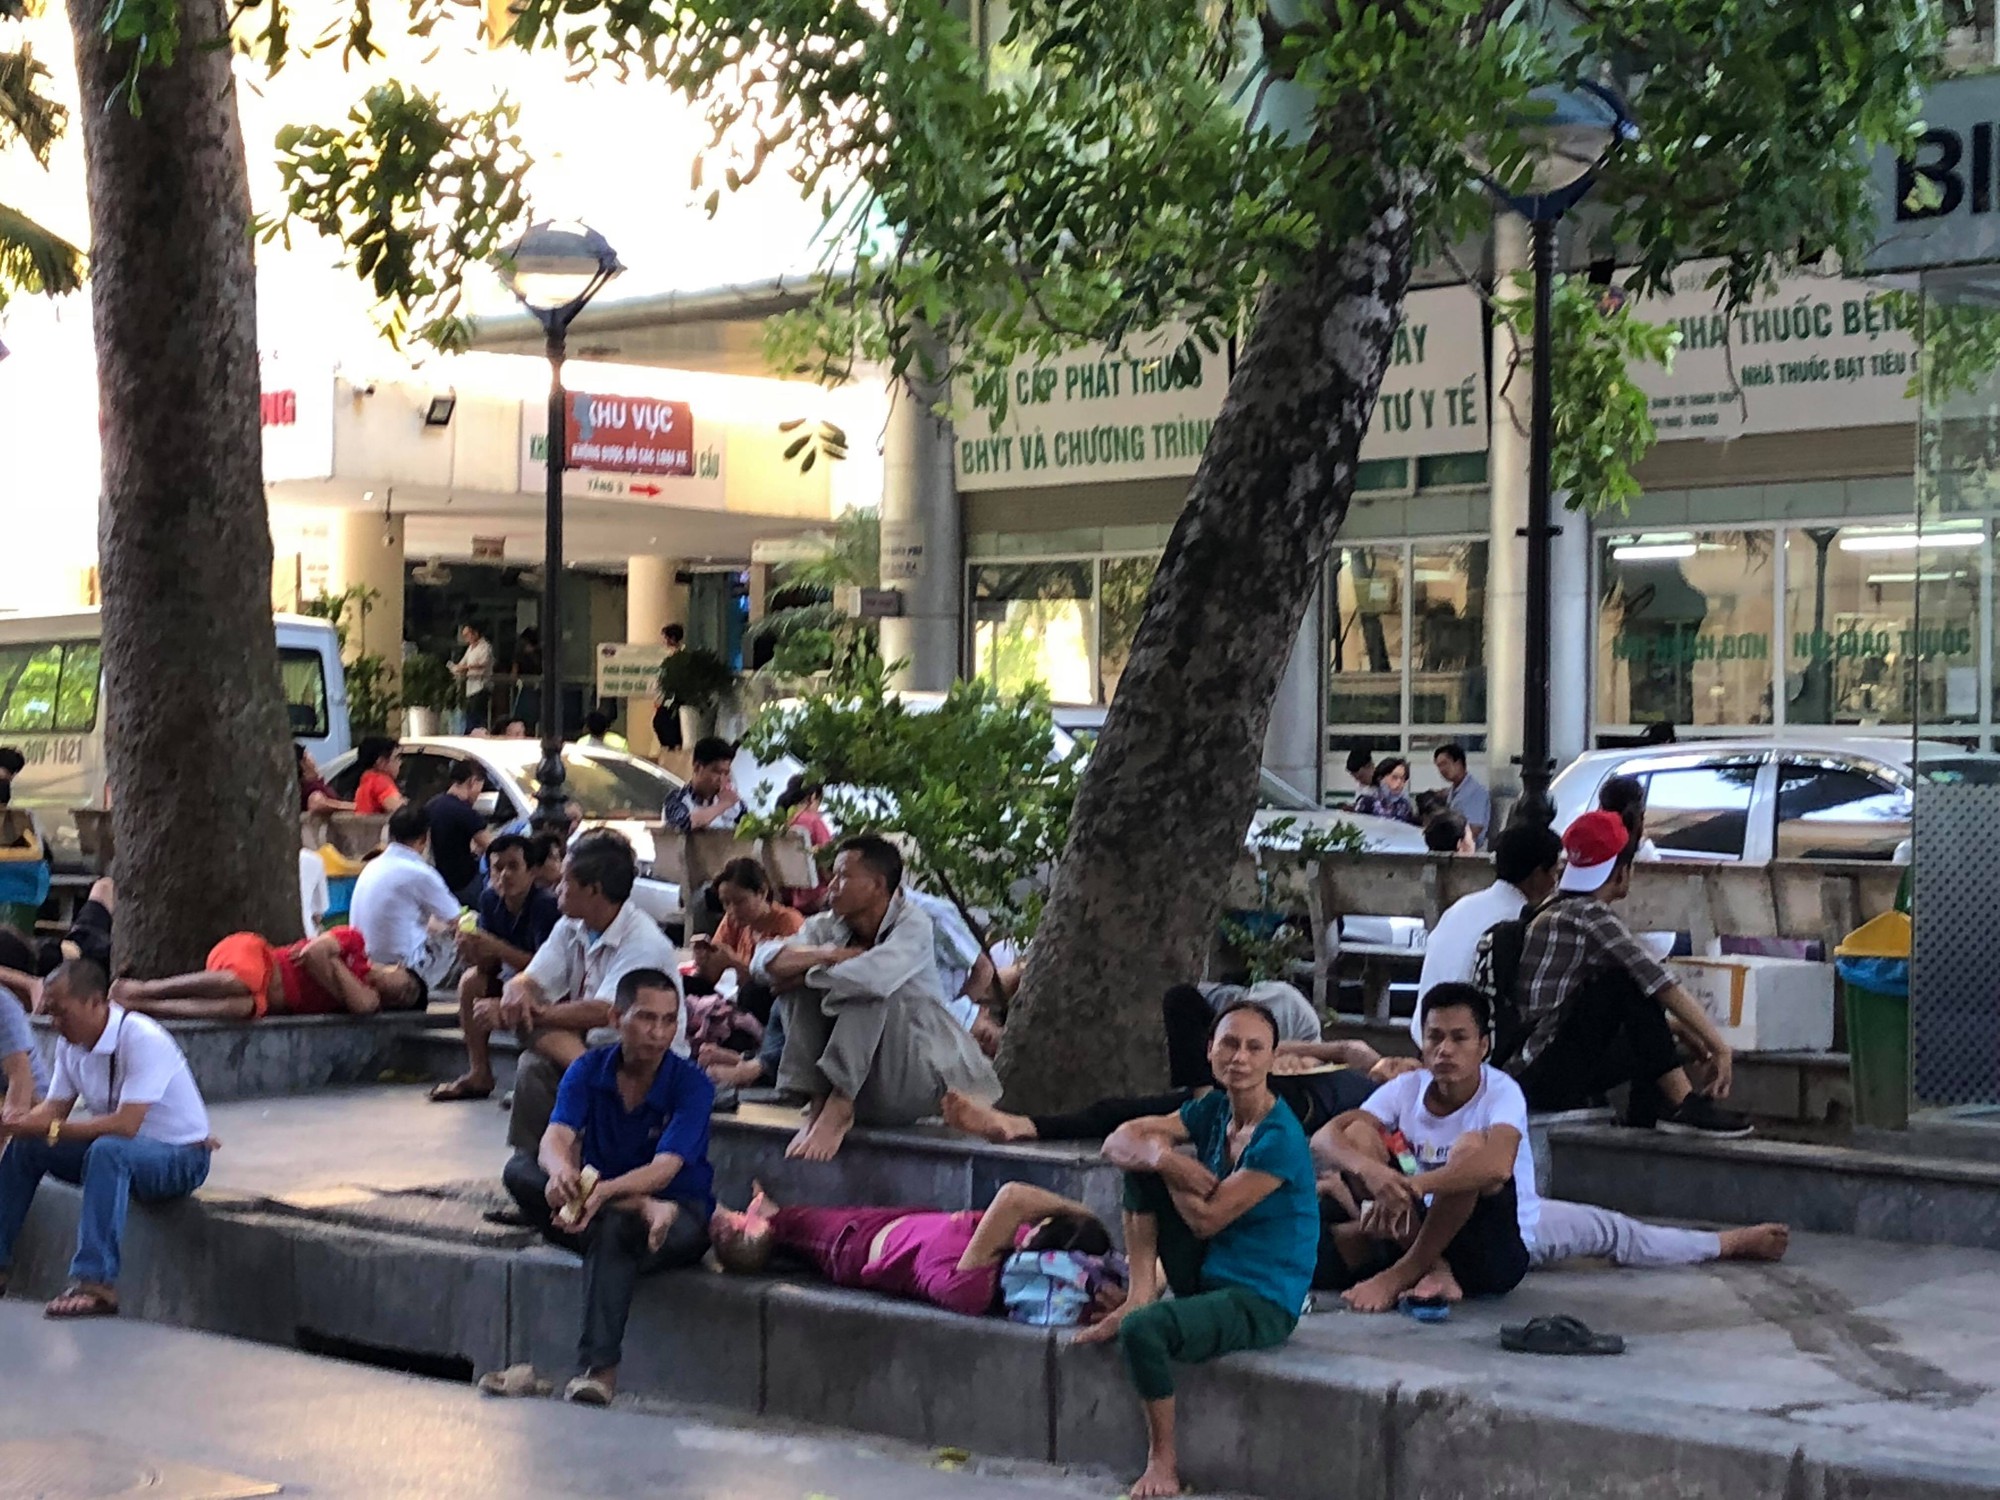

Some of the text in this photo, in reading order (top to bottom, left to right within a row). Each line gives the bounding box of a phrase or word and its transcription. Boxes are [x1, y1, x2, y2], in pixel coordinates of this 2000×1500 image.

[1895, 121, 2000, 221] BI
[1738, 294, 1833, 344] THUỐC
[1777, 353, 1830, 384] THUỐC
[631, 402, 673, 440] VỰC
[1380, 371, 1477, 433] TƯ Y TẾ
[961, 436, 1012, 474] BHYT
[1054, 424, 1145, 467] CHƯƠNG
